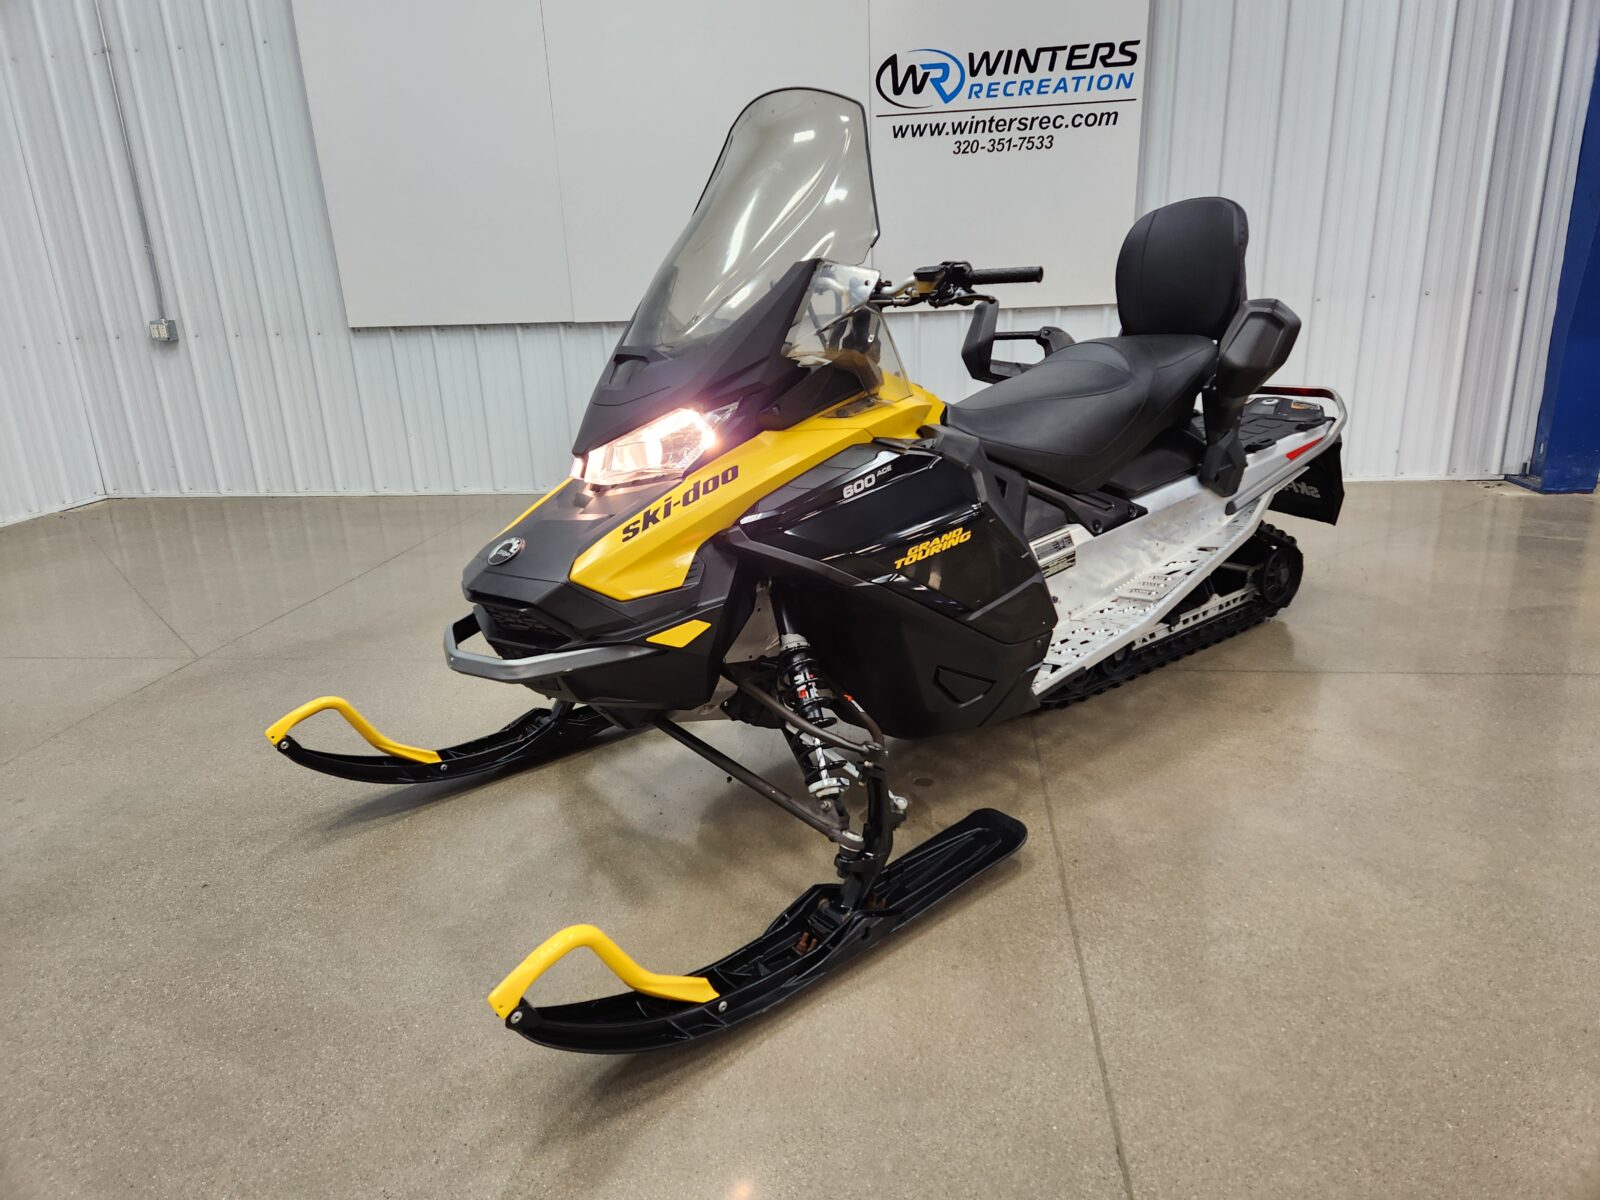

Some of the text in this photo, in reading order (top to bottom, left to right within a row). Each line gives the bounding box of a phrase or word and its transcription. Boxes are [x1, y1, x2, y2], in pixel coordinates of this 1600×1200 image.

[968, 40, 1141, 77] WINTERS
[968, 72, 1135, 99] RECREATION
[892, 111, 1119, 139] www.wintersrec.com
[953, 135, 1054, 155] 320-351-7533
[843, 465, 892, 499] 600 ACE
[894, 531, 972, 570] TOURING
[907, 527, 963, 556] GRAND
